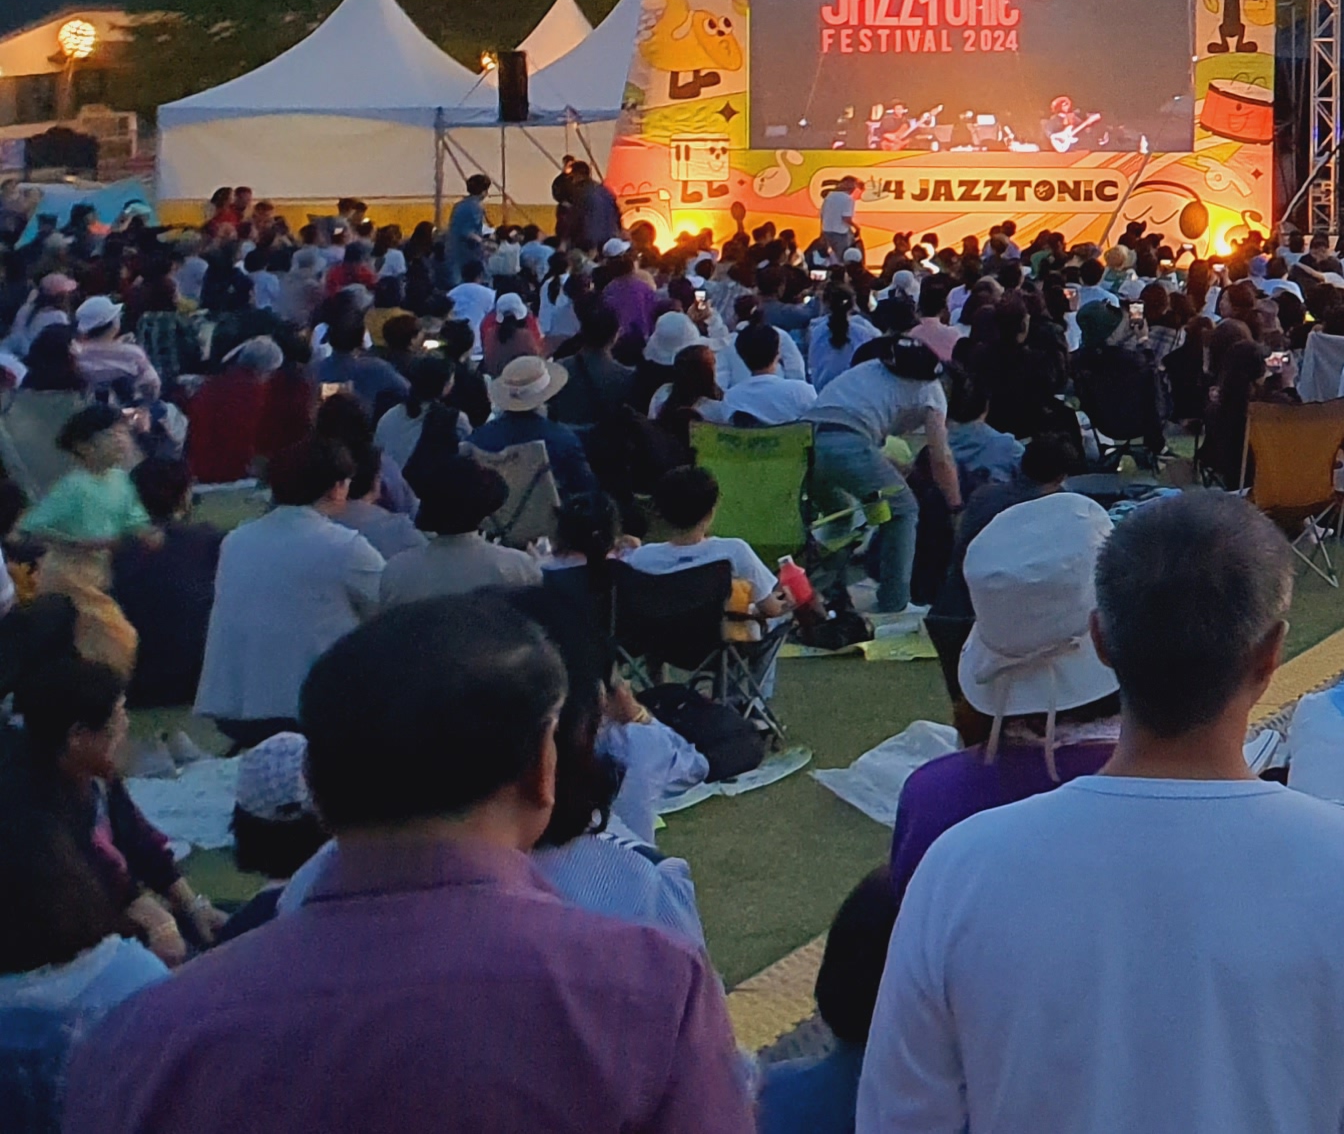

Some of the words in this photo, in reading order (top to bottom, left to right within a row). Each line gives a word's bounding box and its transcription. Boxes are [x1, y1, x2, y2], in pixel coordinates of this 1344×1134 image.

[822, 28, 953, 53] FESTIVAL
[963, 29, 1019, 52] 2024
[911, 179, 1119, 202] JAZZTONIC
